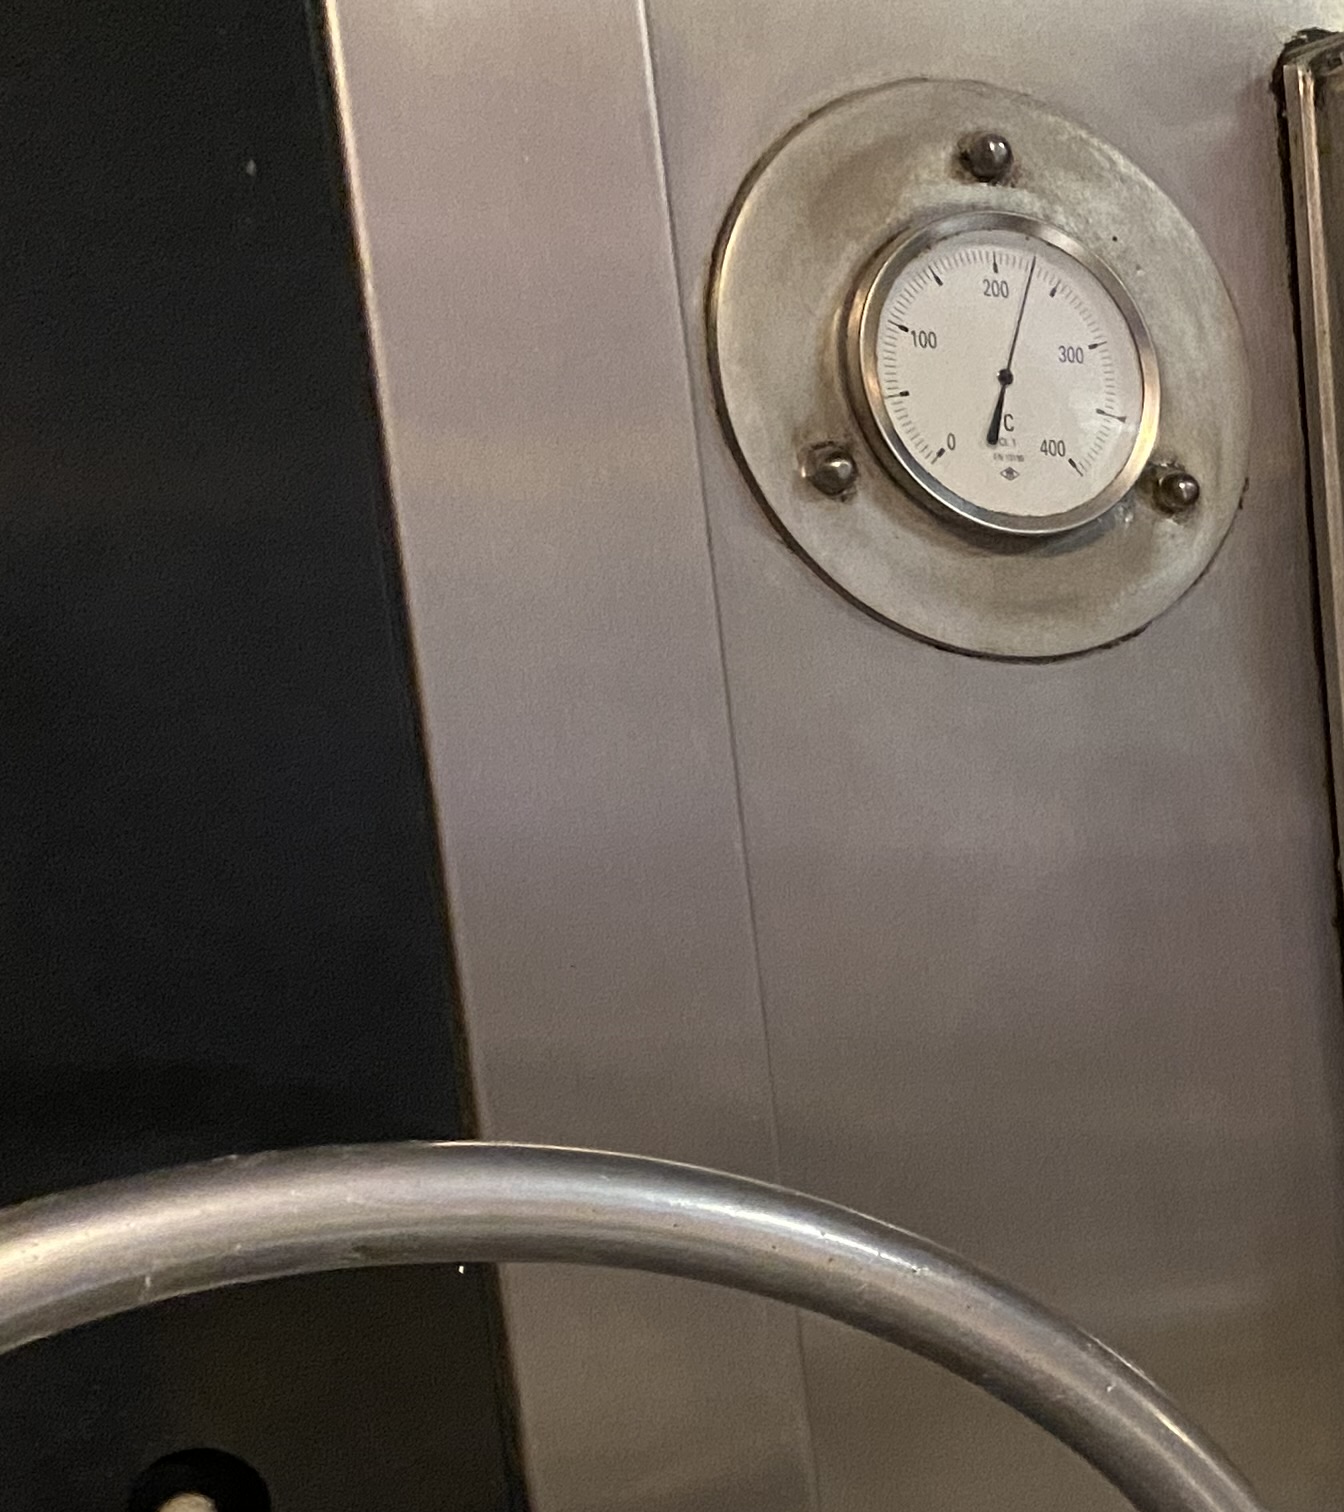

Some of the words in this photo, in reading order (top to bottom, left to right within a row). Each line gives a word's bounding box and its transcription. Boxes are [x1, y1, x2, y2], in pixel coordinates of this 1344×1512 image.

[983, 279, 1008, 298] 200
[911, 330, 937, 349] 100
[1058, 346, 1084, 364] 300
[946, 433, 956, 450] 0
[1040, 439, 1066, 457] 400
